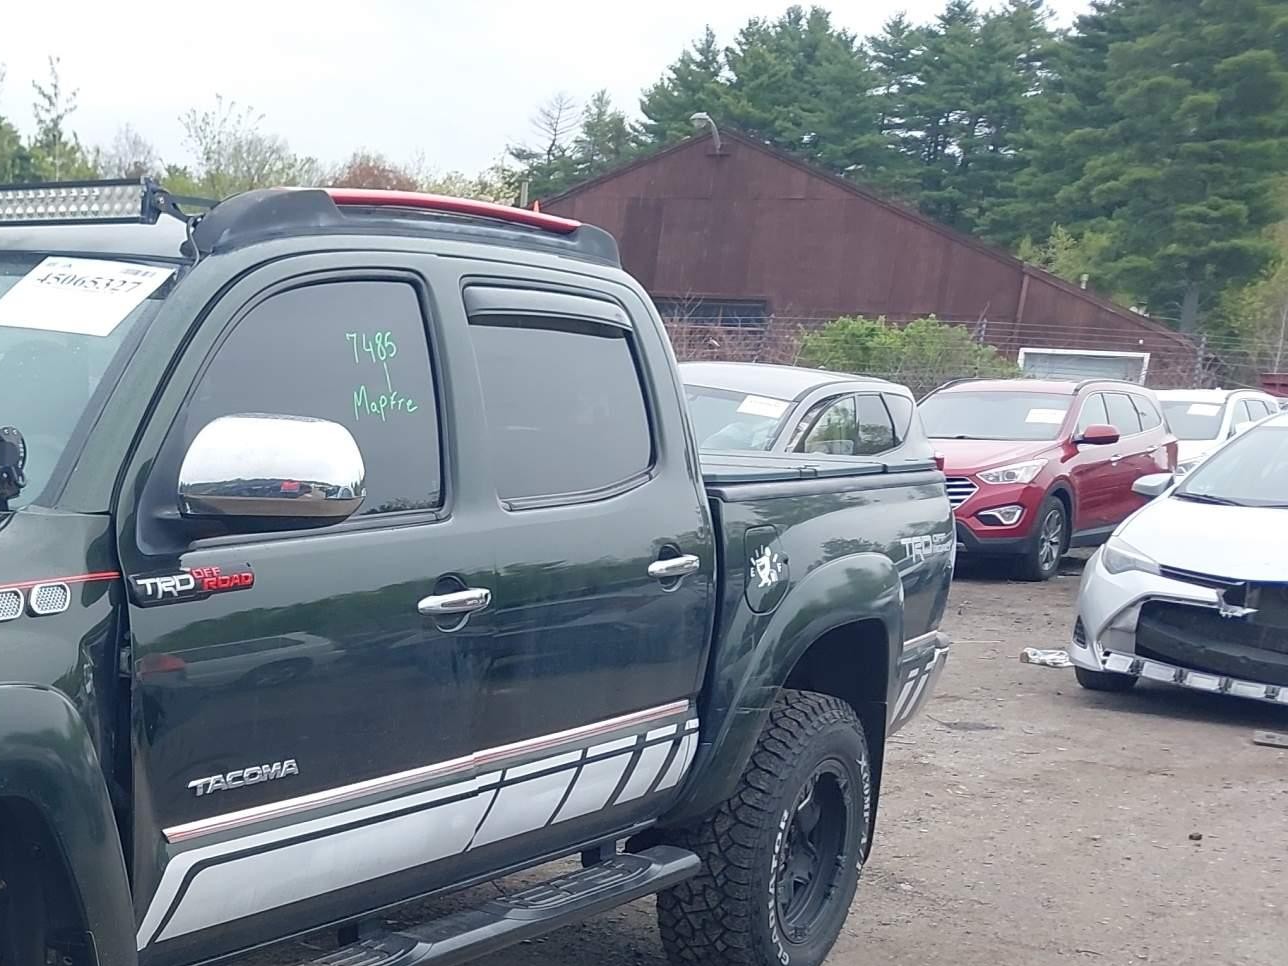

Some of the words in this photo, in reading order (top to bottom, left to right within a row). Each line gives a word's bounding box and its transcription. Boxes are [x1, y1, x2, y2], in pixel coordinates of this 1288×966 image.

[36, 272, 143, 293] 45065327
[345, 331, 397, 363] 7485
[192, 567, 221, 578] OFF
[203, 572, 253, 591] ROAD
[136, 573, 196, 599] TRD
[187, 759, 300, 797] TACOMA
